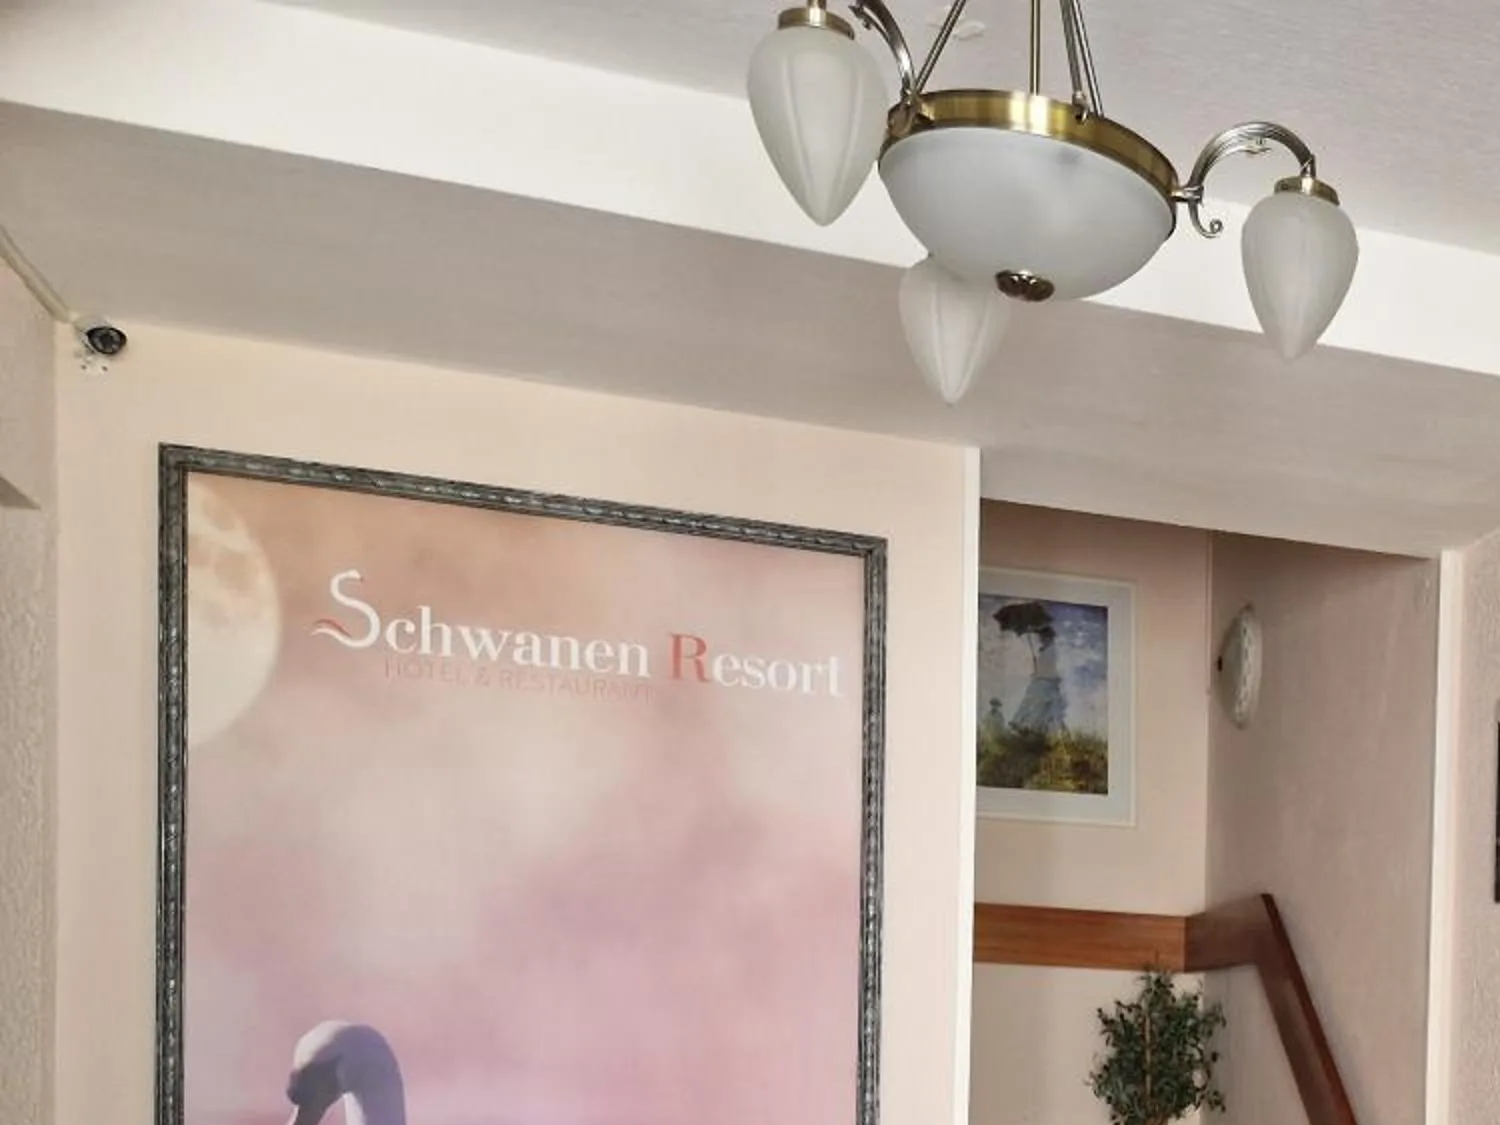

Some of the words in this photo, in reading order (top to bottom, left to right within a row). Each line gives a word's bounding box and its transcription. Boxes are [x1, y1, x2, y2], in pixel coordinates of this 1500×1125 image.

[312, 569, 651, 678] Schwanen
[669, 633, 845, 698] Resort
[384, 654, 467, 688] HOTEL
[475, 667, 491, 688] &
[499, 670, 657, 705] RESTAURANT
